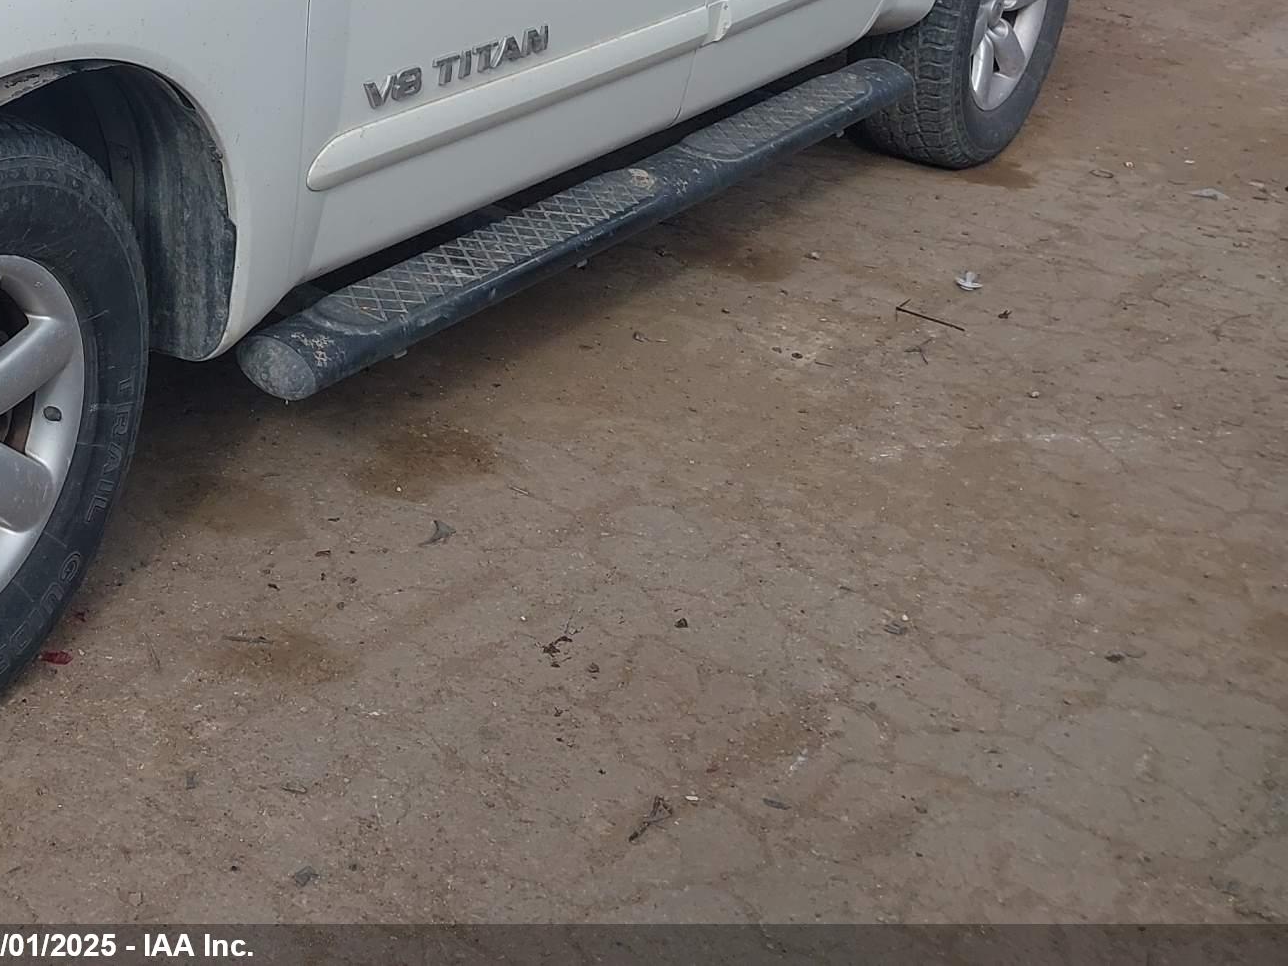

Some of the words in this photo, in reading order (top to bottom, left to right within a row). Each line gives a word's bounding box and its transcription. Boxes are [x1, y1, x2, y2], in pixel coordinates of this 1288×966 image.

[363, 66, 423, 110] V8
[432, 23, 550, 86] TITAN
[85, 377, 135, 523] TRAIL
